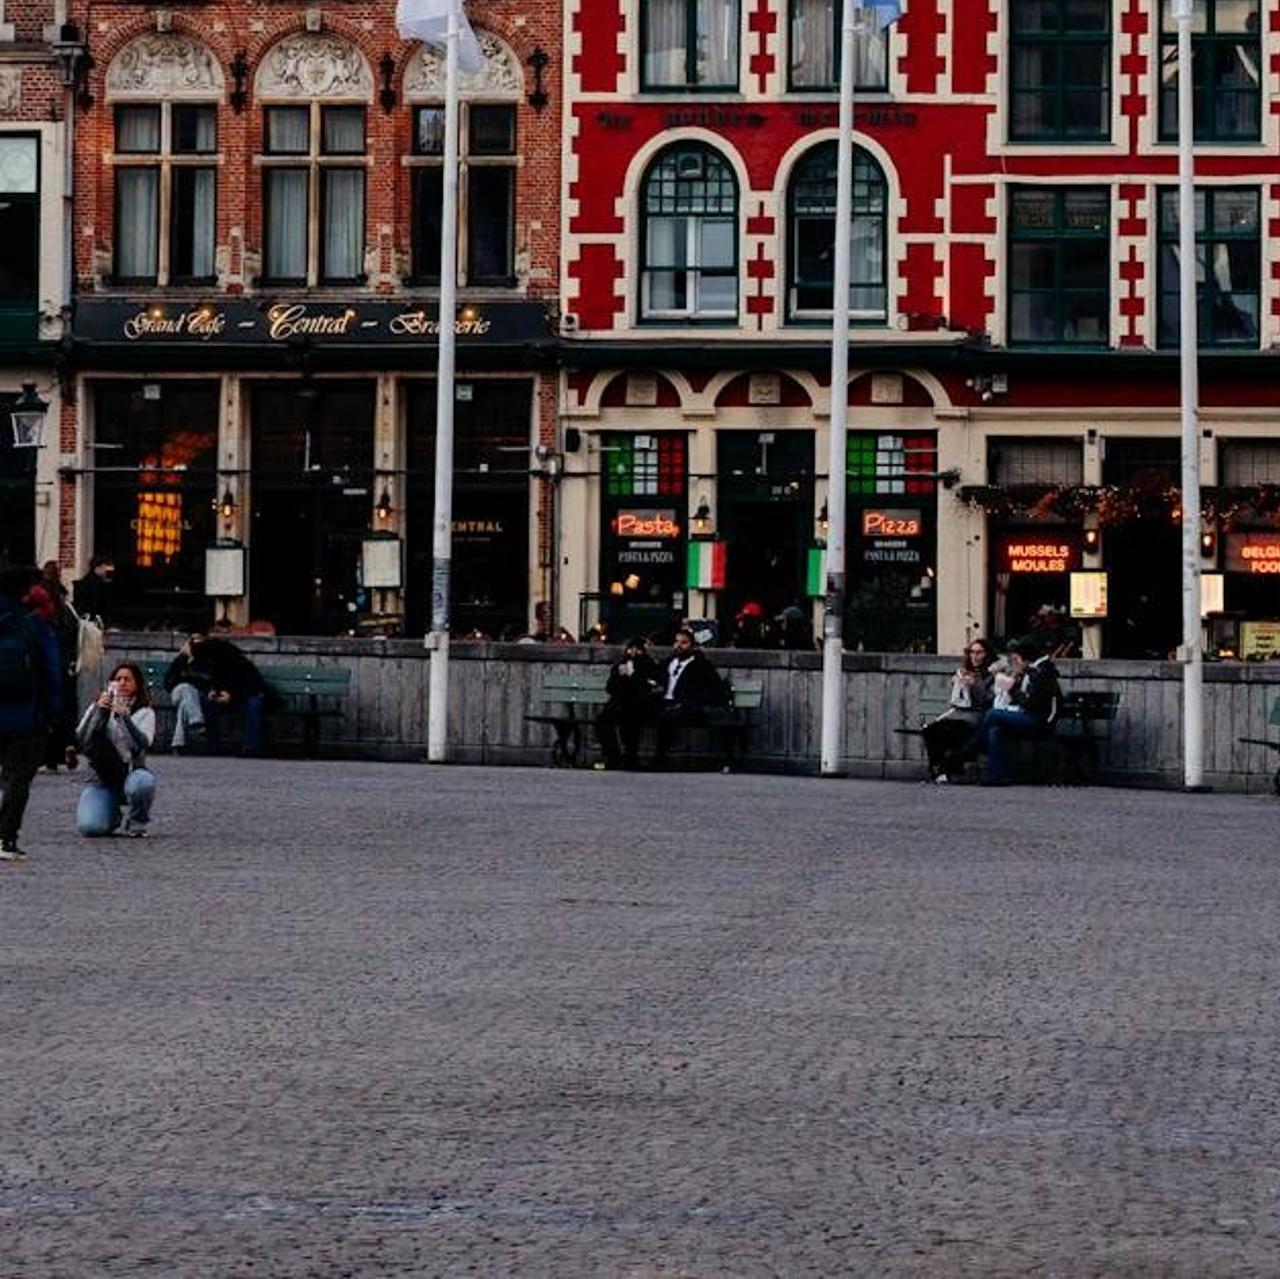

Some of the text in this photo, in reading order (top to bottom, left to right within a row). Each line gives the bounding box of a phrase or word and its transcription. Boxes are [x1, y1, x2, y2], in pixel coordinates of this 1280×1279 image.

[124, 312, 185, 339] Grand
[268, 304, 355, 340] Central
[390, 311, 491, 335] Braerie
[618, 513, 678, 536] Pasta
[865, 512, 918, 535] Pizza
[1008, 545, 1069, 557] MUSSELS
[1012, 560, 1065, 572] MOULES
